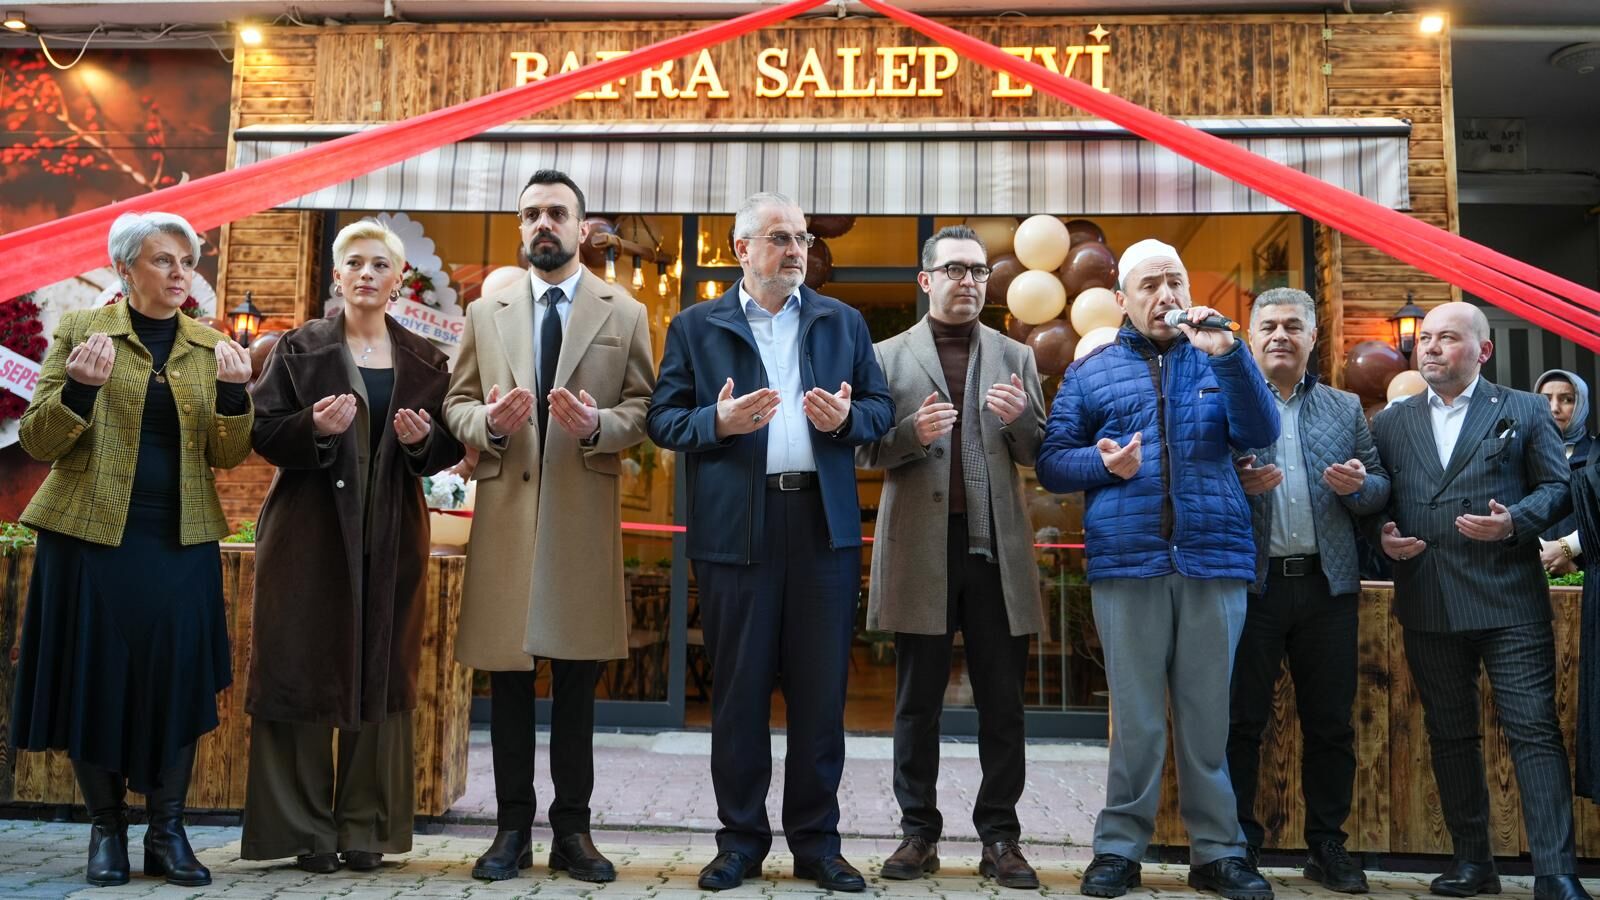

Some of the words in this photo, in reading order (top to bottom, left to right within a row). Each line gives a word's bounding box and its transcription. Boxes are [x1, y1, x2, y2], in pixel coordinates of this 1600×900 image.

[750, 46, 961, 98] SALEP
[1462, 129, 1489, 140] OCAK
[1501, 130, 1521, 140] APT
